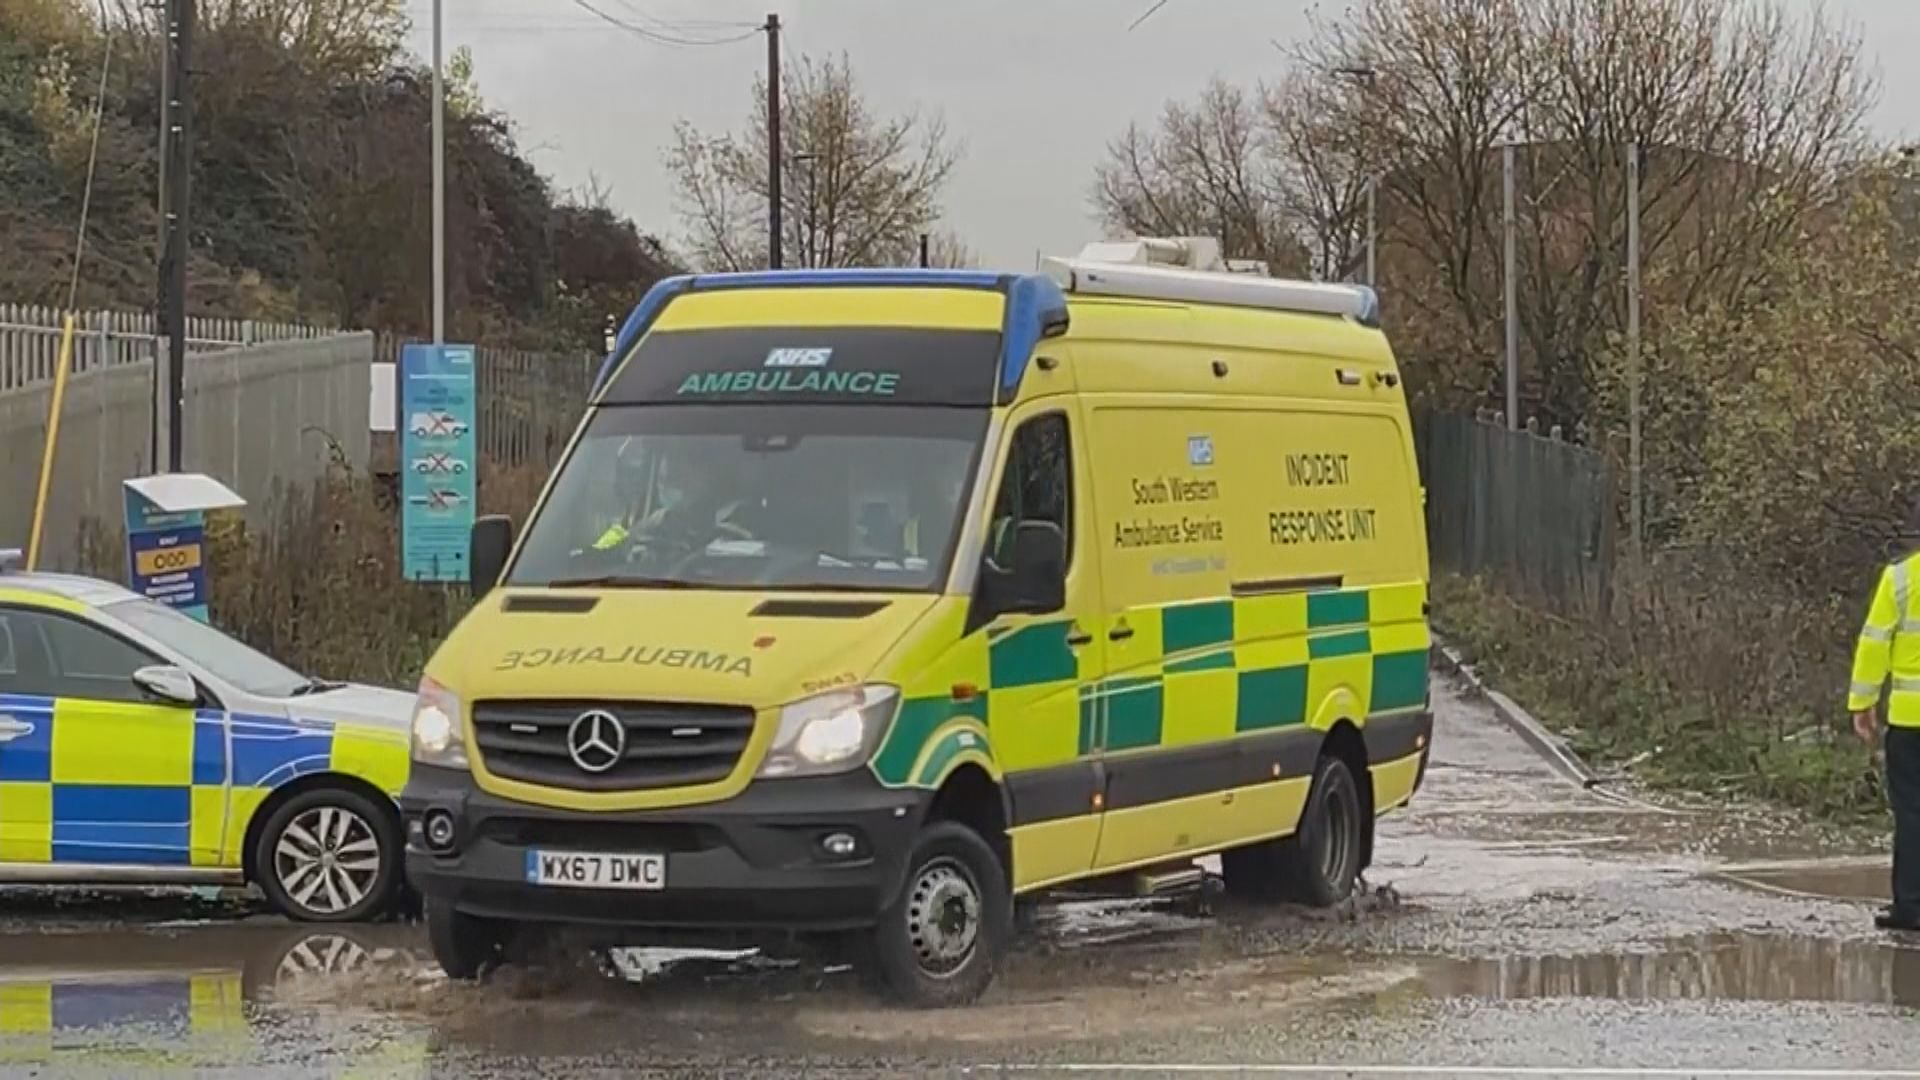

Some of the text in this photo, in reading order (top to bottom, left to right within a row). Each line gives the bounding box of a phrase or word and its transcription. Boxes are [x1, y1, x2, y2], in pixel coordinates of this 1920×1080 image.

[766, 348, 831, 367] NHS
[677, 371, 900, 395] AMBULANCE
[1285, 454, 1349, 487] INCIDENT
[1132, 476, 1219, 505] South Western
[1115, 515, 1222, 548] Ambulance Service
[1269, 508, 1376, 544] RESPONSE UNIT
[542, 856, 601, 881] WX67
[610, 857, 658, 883] DWC
